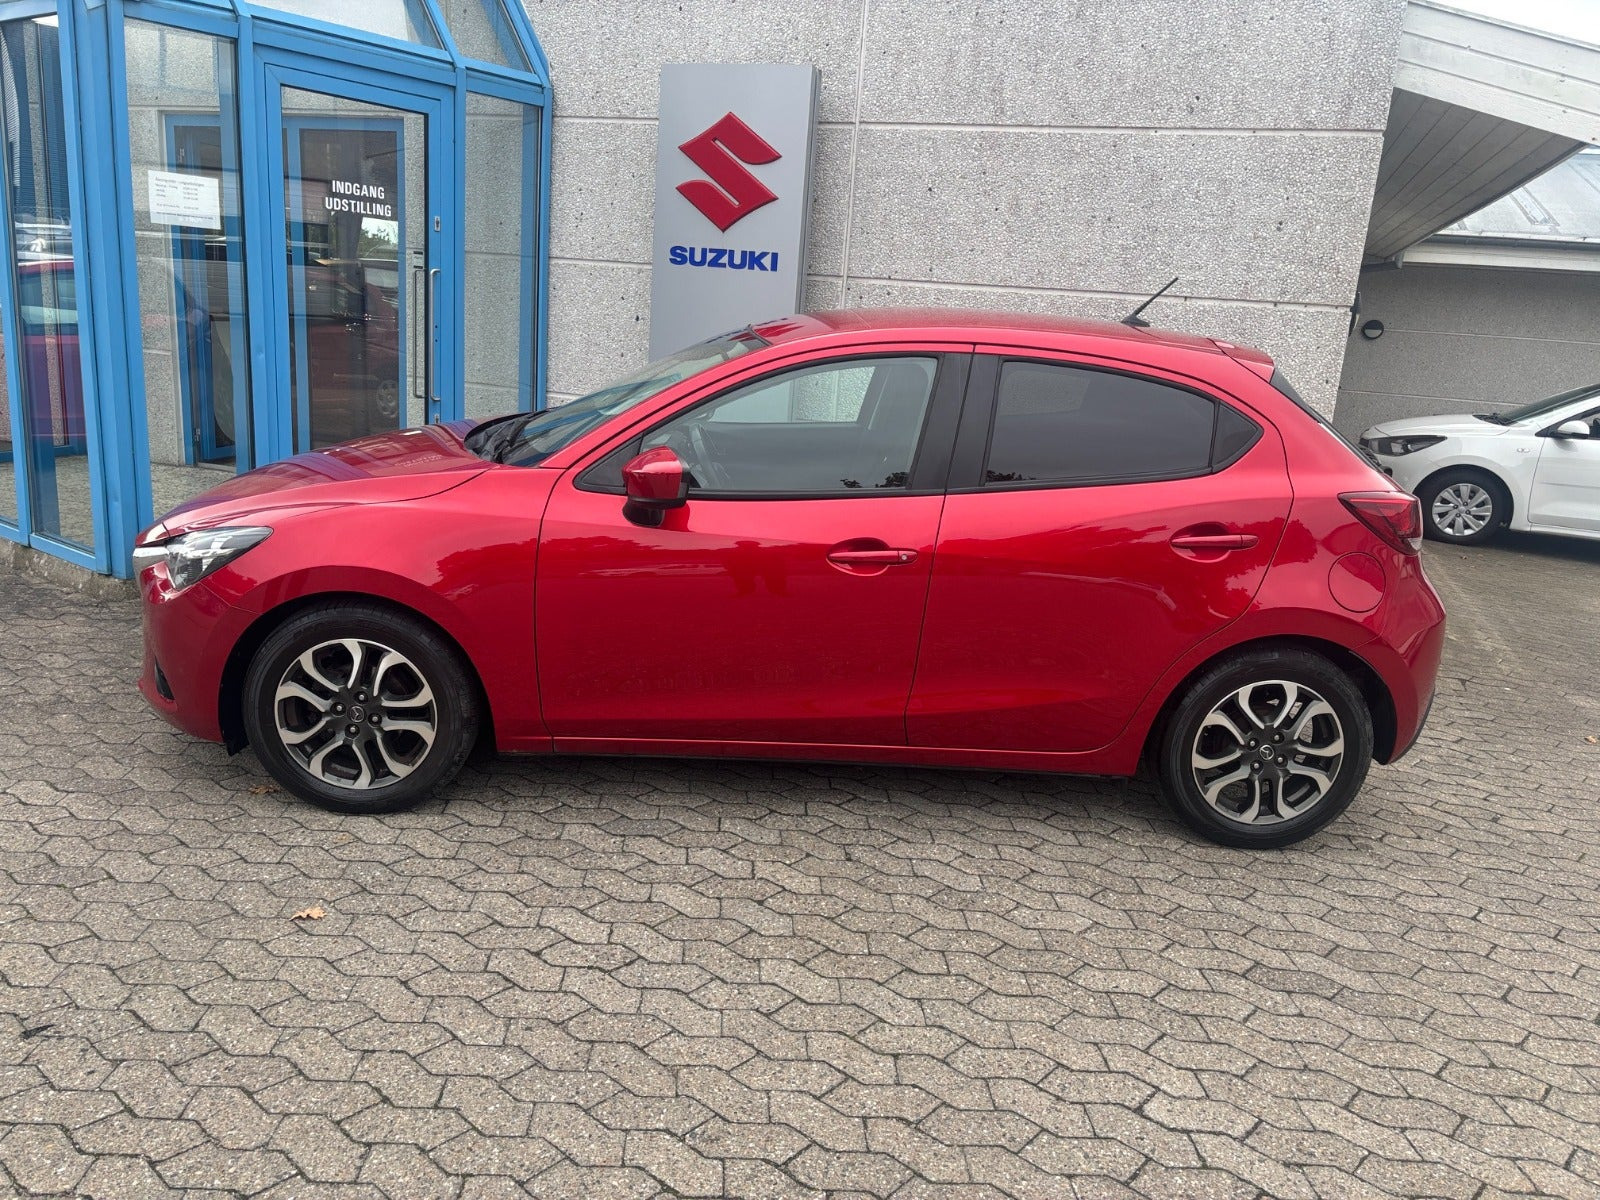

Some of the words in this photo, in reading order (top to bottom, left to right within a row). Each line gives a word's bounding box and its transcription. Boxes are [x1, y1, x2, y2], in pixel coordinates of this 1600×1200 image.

[332, 180, 385, 199] INDGANG
[325, 197, 392, 217] UDSTILLING
[669, 245, 779, 272] SUZUKI
